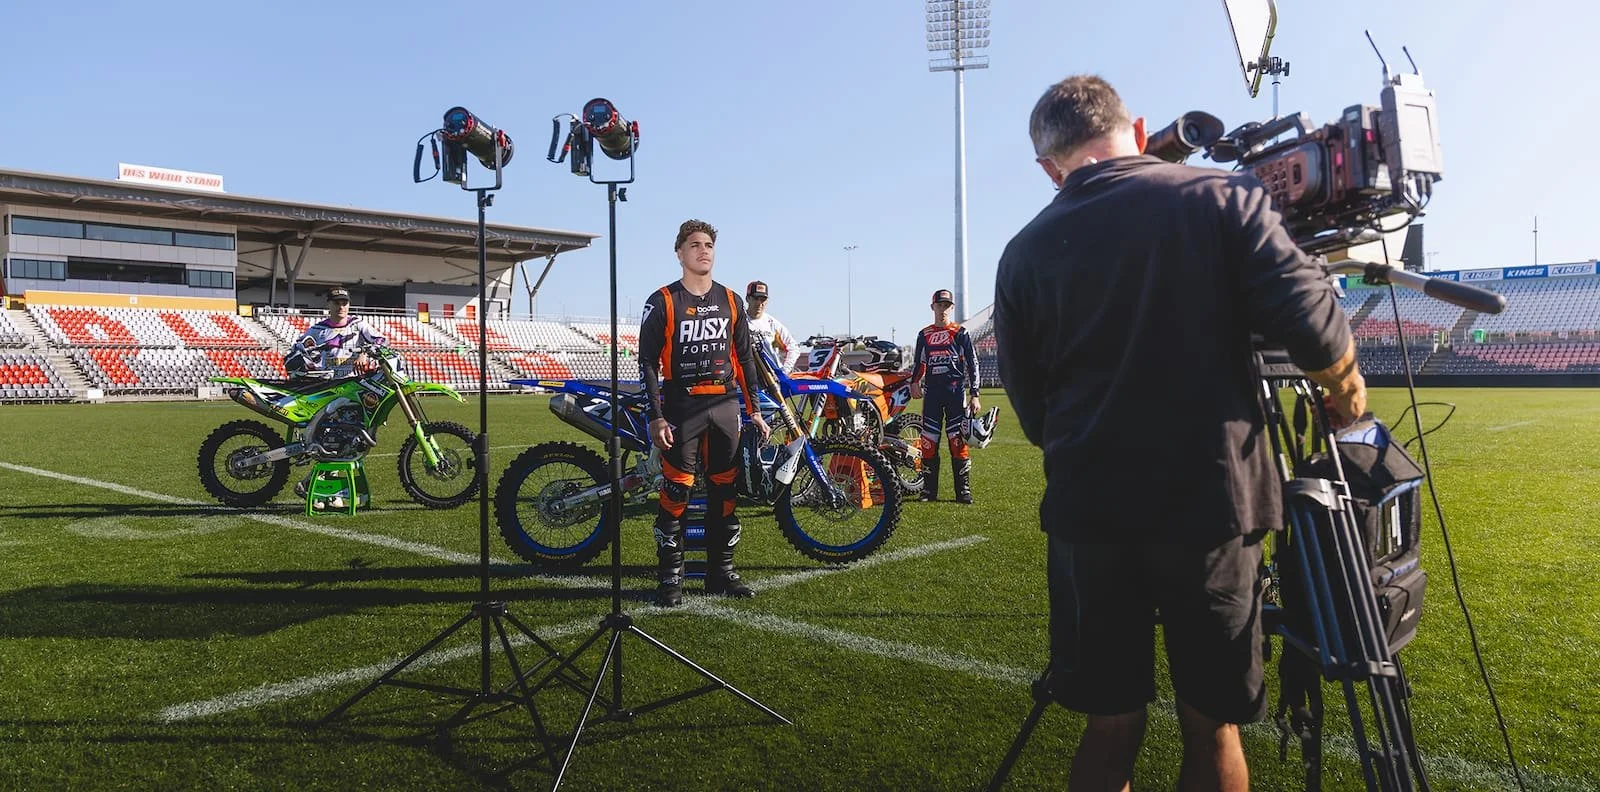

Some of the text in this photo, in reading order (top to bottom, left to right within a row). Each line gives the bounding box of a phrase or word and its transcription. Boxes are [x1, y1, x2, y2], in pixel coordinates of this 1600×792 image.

[185, 175, 221, 187] STAND
[1462, 270, 1500, 280] KINGS
[1506, 267, 1545, 277] KINGS
[1551, 264, 1593, 275] KINGS
[697, 305, 720, 313] boost
[680, 318, 730, 343] AUSX
[683, 343, 726, 355] FORTH
[809, 350, 831, 367] 3
